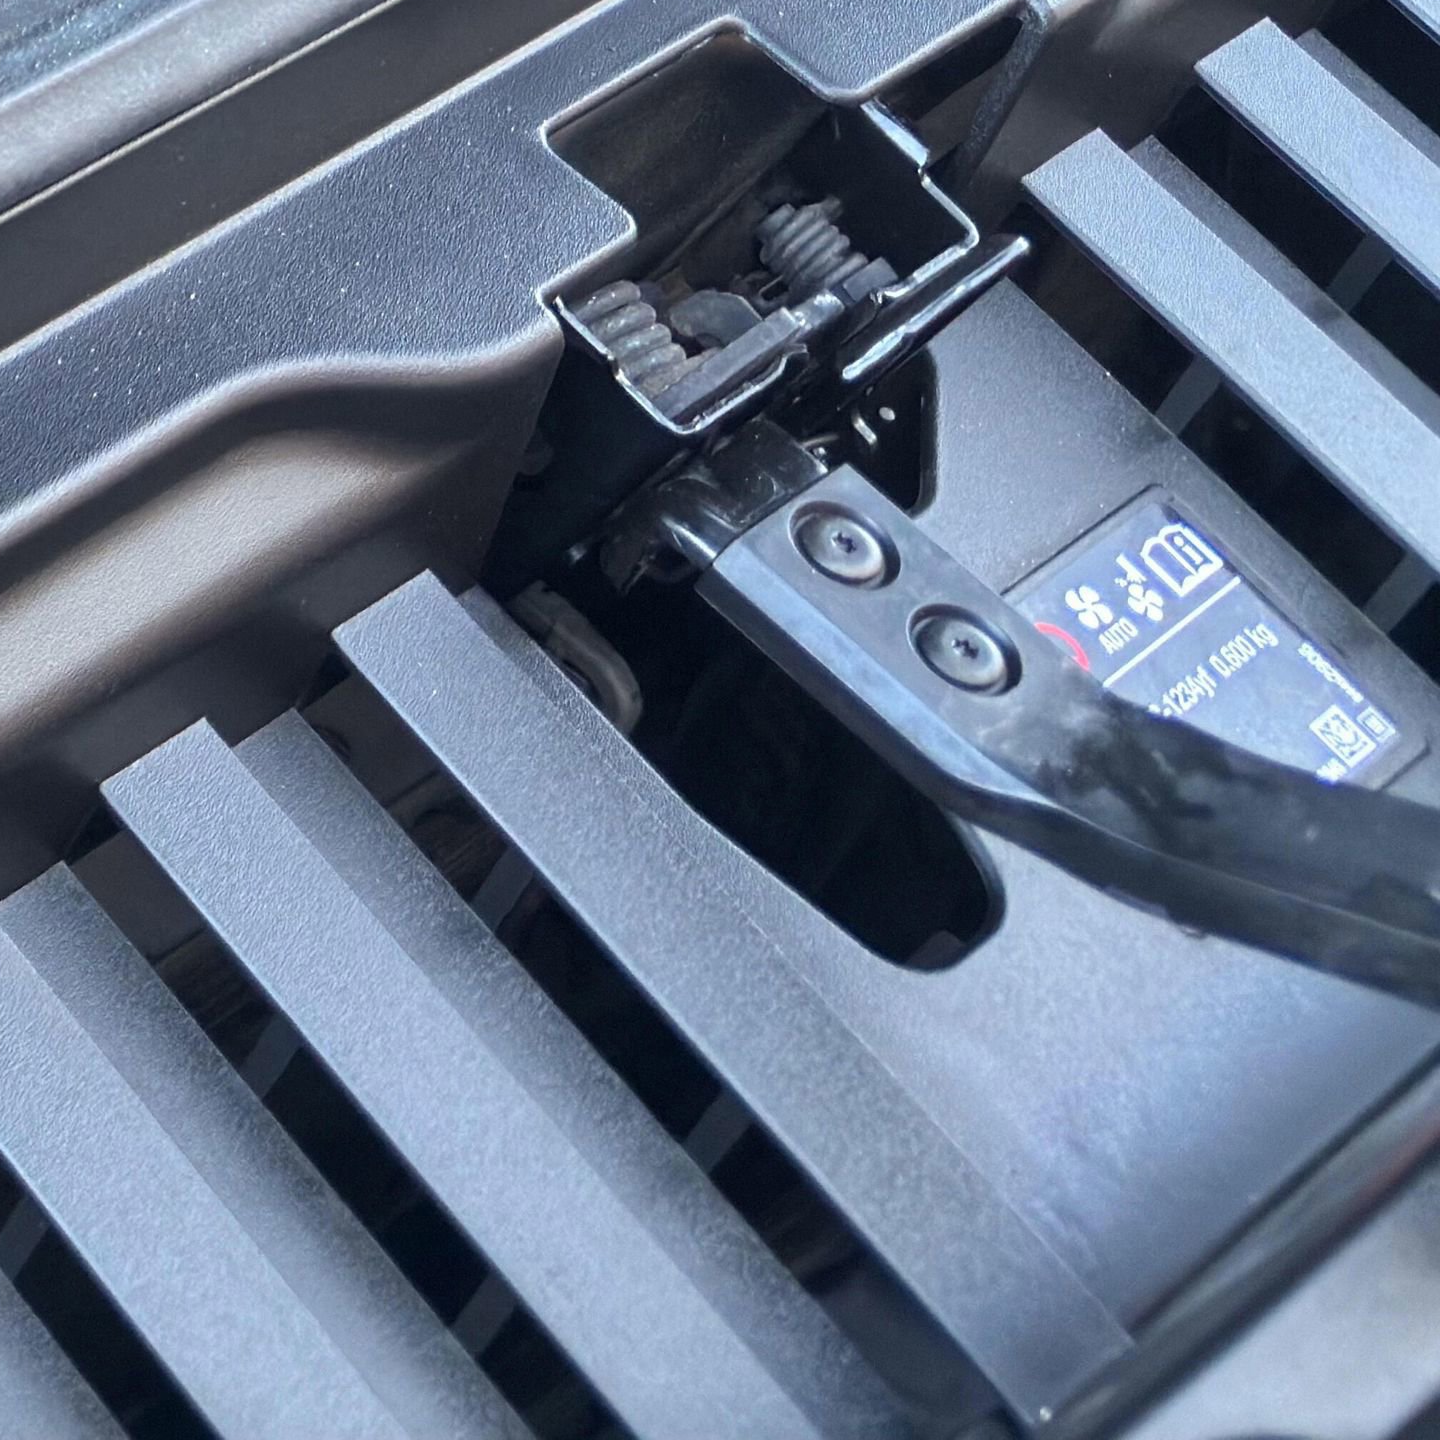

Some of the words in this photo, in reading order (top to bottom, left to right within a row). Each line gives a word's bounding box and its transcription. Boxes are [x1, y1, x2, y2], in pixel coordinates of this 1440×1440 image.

[1098, 617, 1139, 655] AUTO
[1208, 634, 1257, 679] 0.600
[1243, 623, 1279, 649] kg
